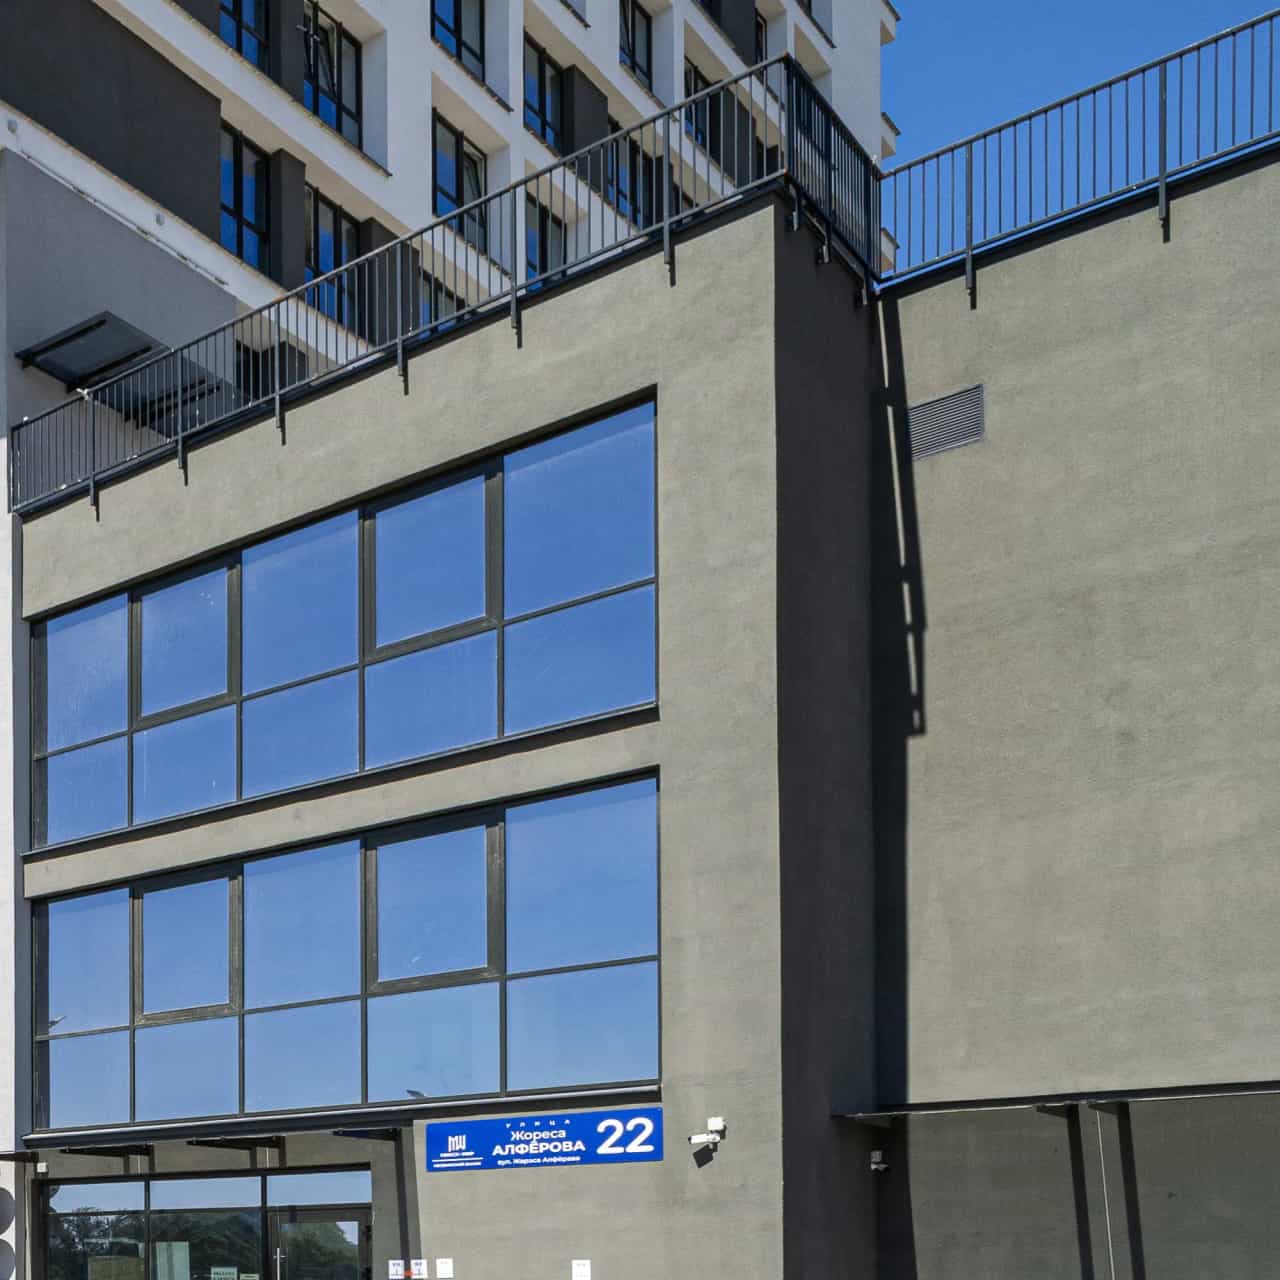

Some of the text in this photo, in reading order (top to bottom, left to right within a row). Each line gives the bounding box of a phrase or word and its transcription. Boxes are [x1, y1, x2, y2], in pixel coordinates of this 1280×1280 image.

[510, 1129, 567, 1142] Жореса
[596, 1116, 655, 1155] 22
[492, 1140, 586, 1156] АЛФЁРОВА
